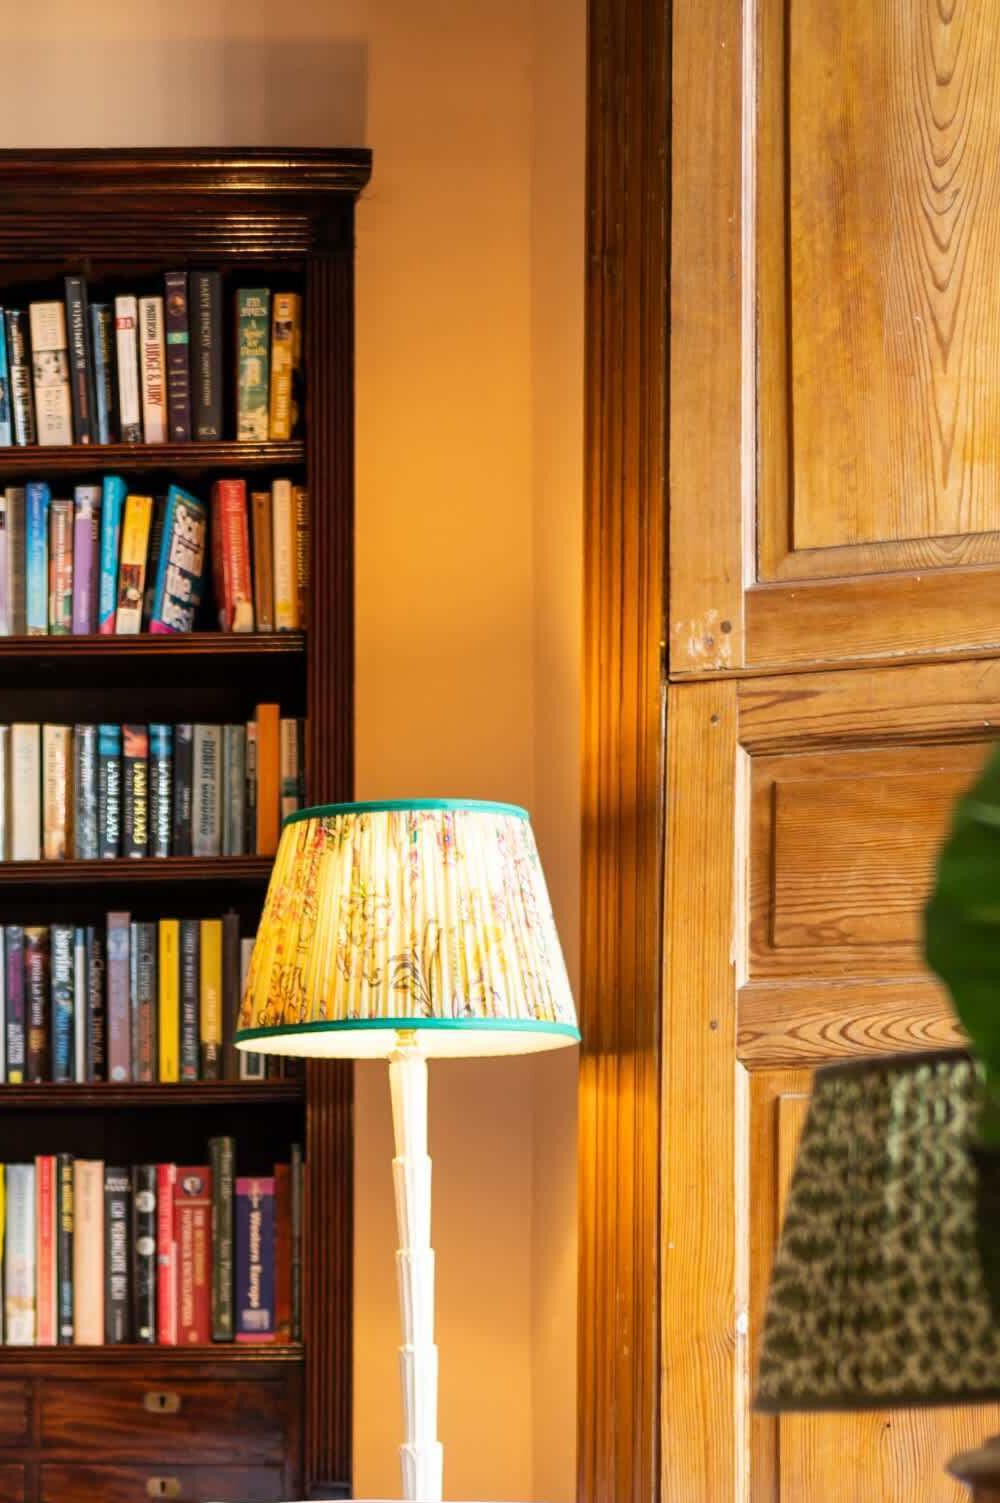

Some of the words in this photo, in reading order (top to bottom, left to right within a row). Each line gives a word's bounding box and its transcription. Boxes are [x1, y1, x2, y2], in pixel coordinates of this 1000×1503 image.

[145, 342, 161, 371] JUDGE
[147, 384, 163, 407] JURY
[133, 762, 146, 796] TAMI
[133, 799, 147, 844] HOAG
[184, 1003, 195, 1024] JANE
[110, 1200, 125, 1218] ICH
[250, 1211, 262, 1262] Western
[111, 1276, 127, 1301] DICH
[247, 1265, 262, 1308] Europe
